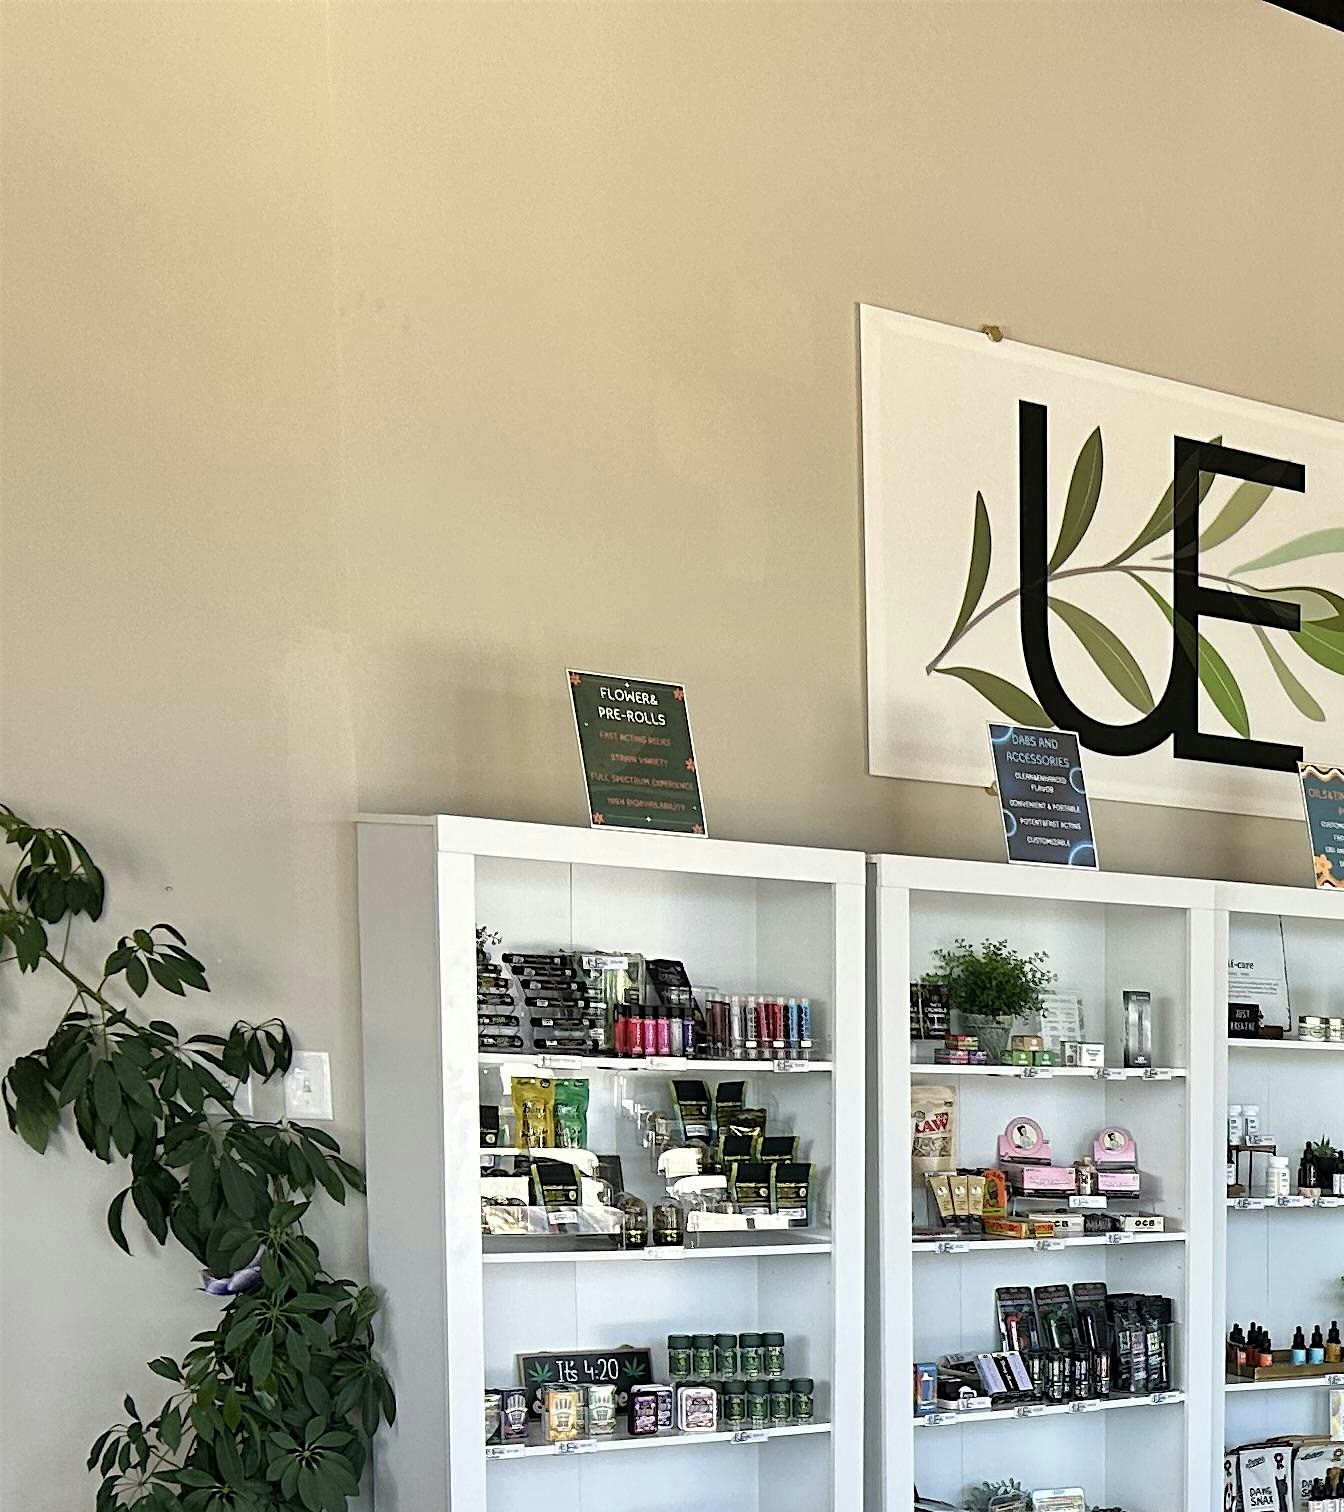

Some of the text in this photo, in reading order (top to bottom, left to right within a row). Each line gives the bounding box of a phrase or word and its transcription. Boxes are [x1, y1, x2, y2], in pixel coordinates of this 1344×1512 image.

[600, 687, 658, 706] FLOWER&
[598, 706, 666, 726] PRE-ROLLS
[600, 731, 618, 740] FAST
[620, 733, 647, 743] ACTING
[1012, 733, 1058, 750] DABS AND
[1006, 751, 1070, 768] ACCESSORIES
[612, 774, 650, 785] SPECTRUM
[1054, 1220, 1069, 1228] CB
[1134, 1219, 1155, 1227] OCB
[556, 1358, 619, 1382] It's 4:20
